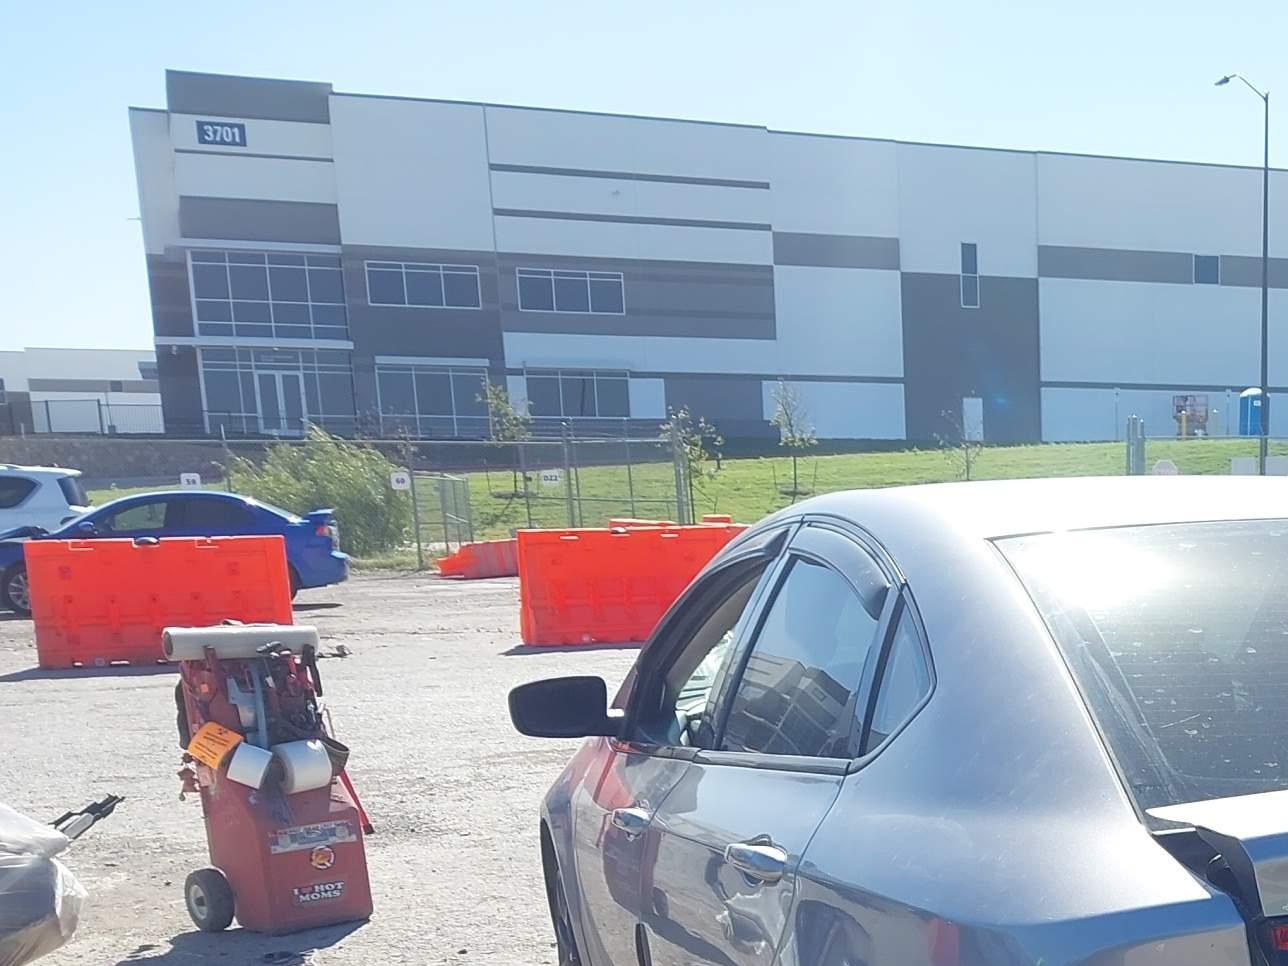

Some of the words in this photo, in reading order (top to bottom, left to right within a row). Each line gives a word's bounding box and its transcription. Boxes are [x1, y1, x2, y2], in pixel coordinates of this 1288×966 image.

[203, 125, 240, 142] 3701
[314, 881, 345, 893] HOT
[299, 890, 341, 902] MOMS
